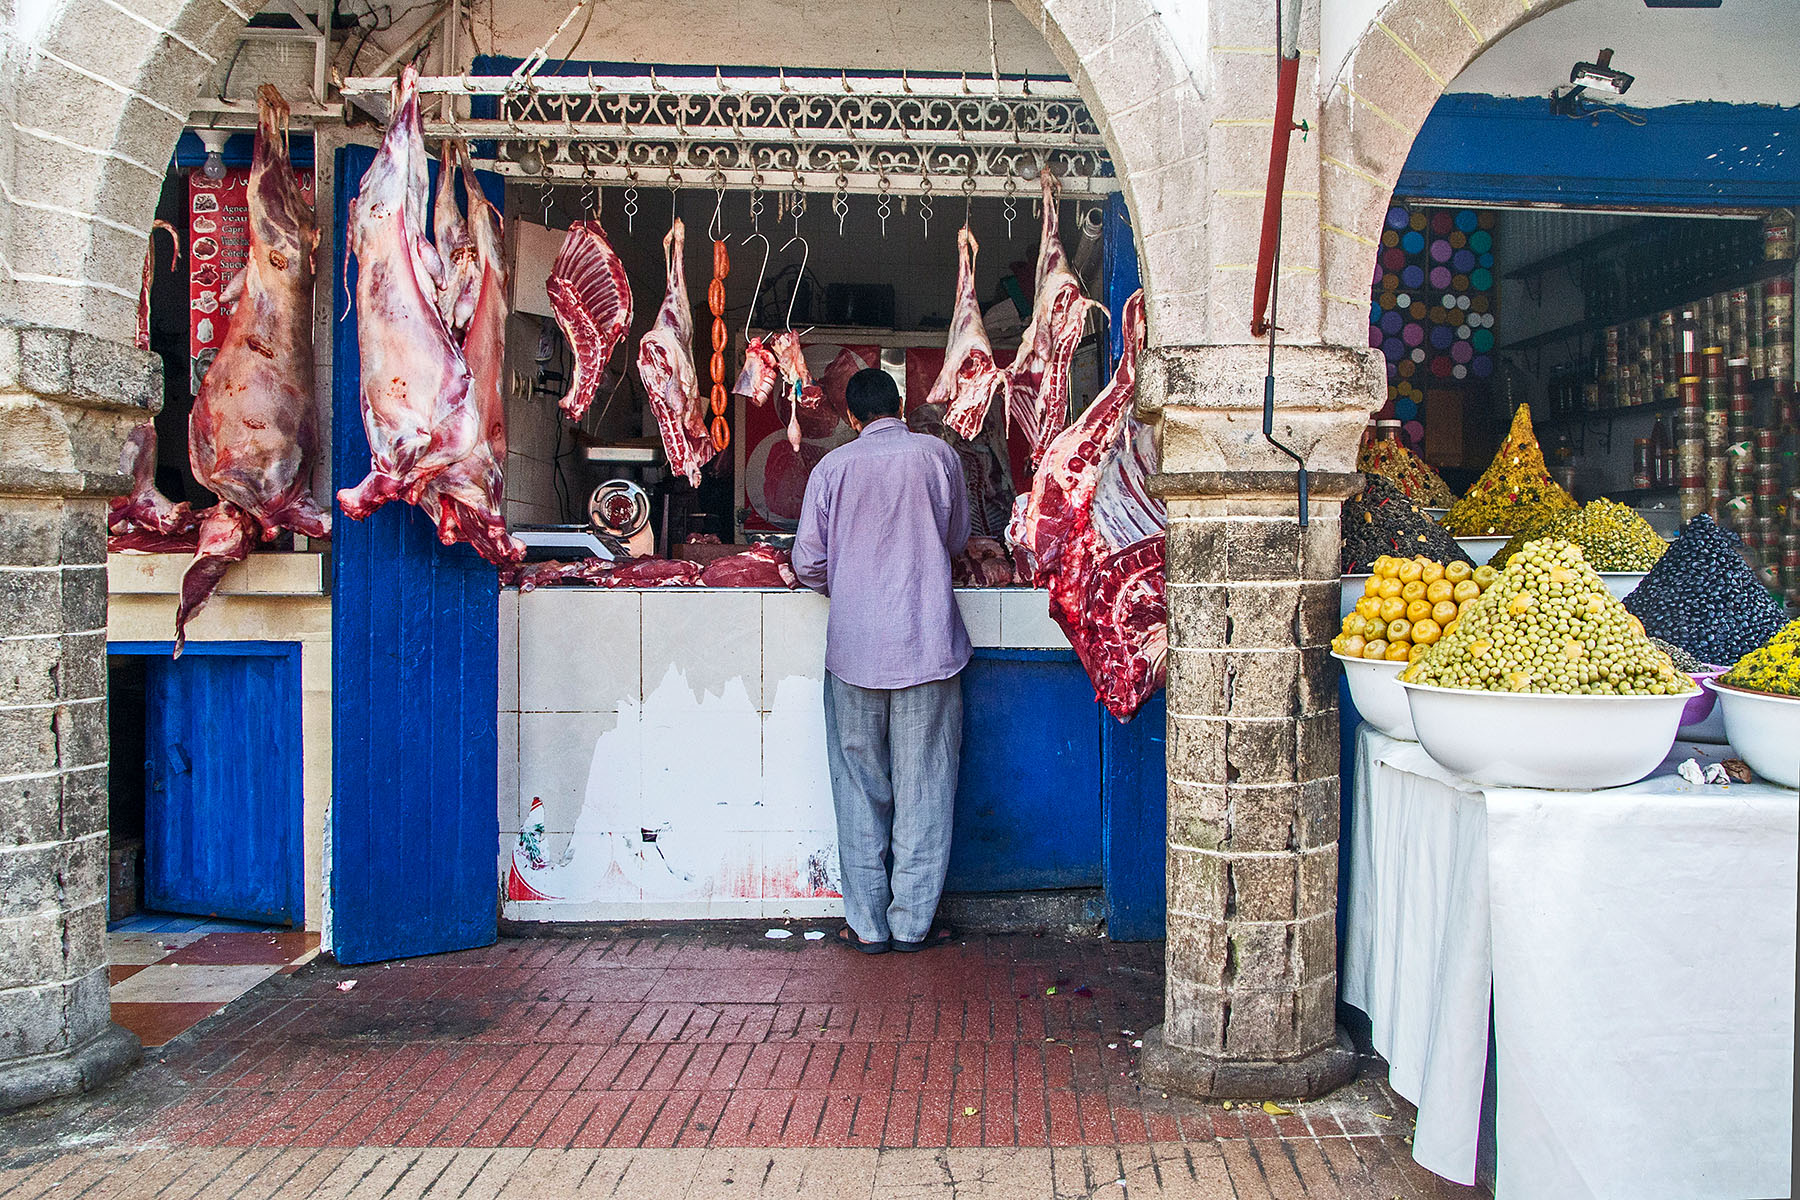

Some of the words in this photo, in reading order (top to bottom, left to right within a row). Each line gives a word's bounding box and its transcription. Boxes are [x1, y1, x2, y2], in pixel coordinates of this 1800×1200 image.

[222, 204, 248, 215] Agnea
[220, 259, 246, 268] Saucis
[221, 271, 233, 281] Fil
[220, 306, 232, 316] Po
